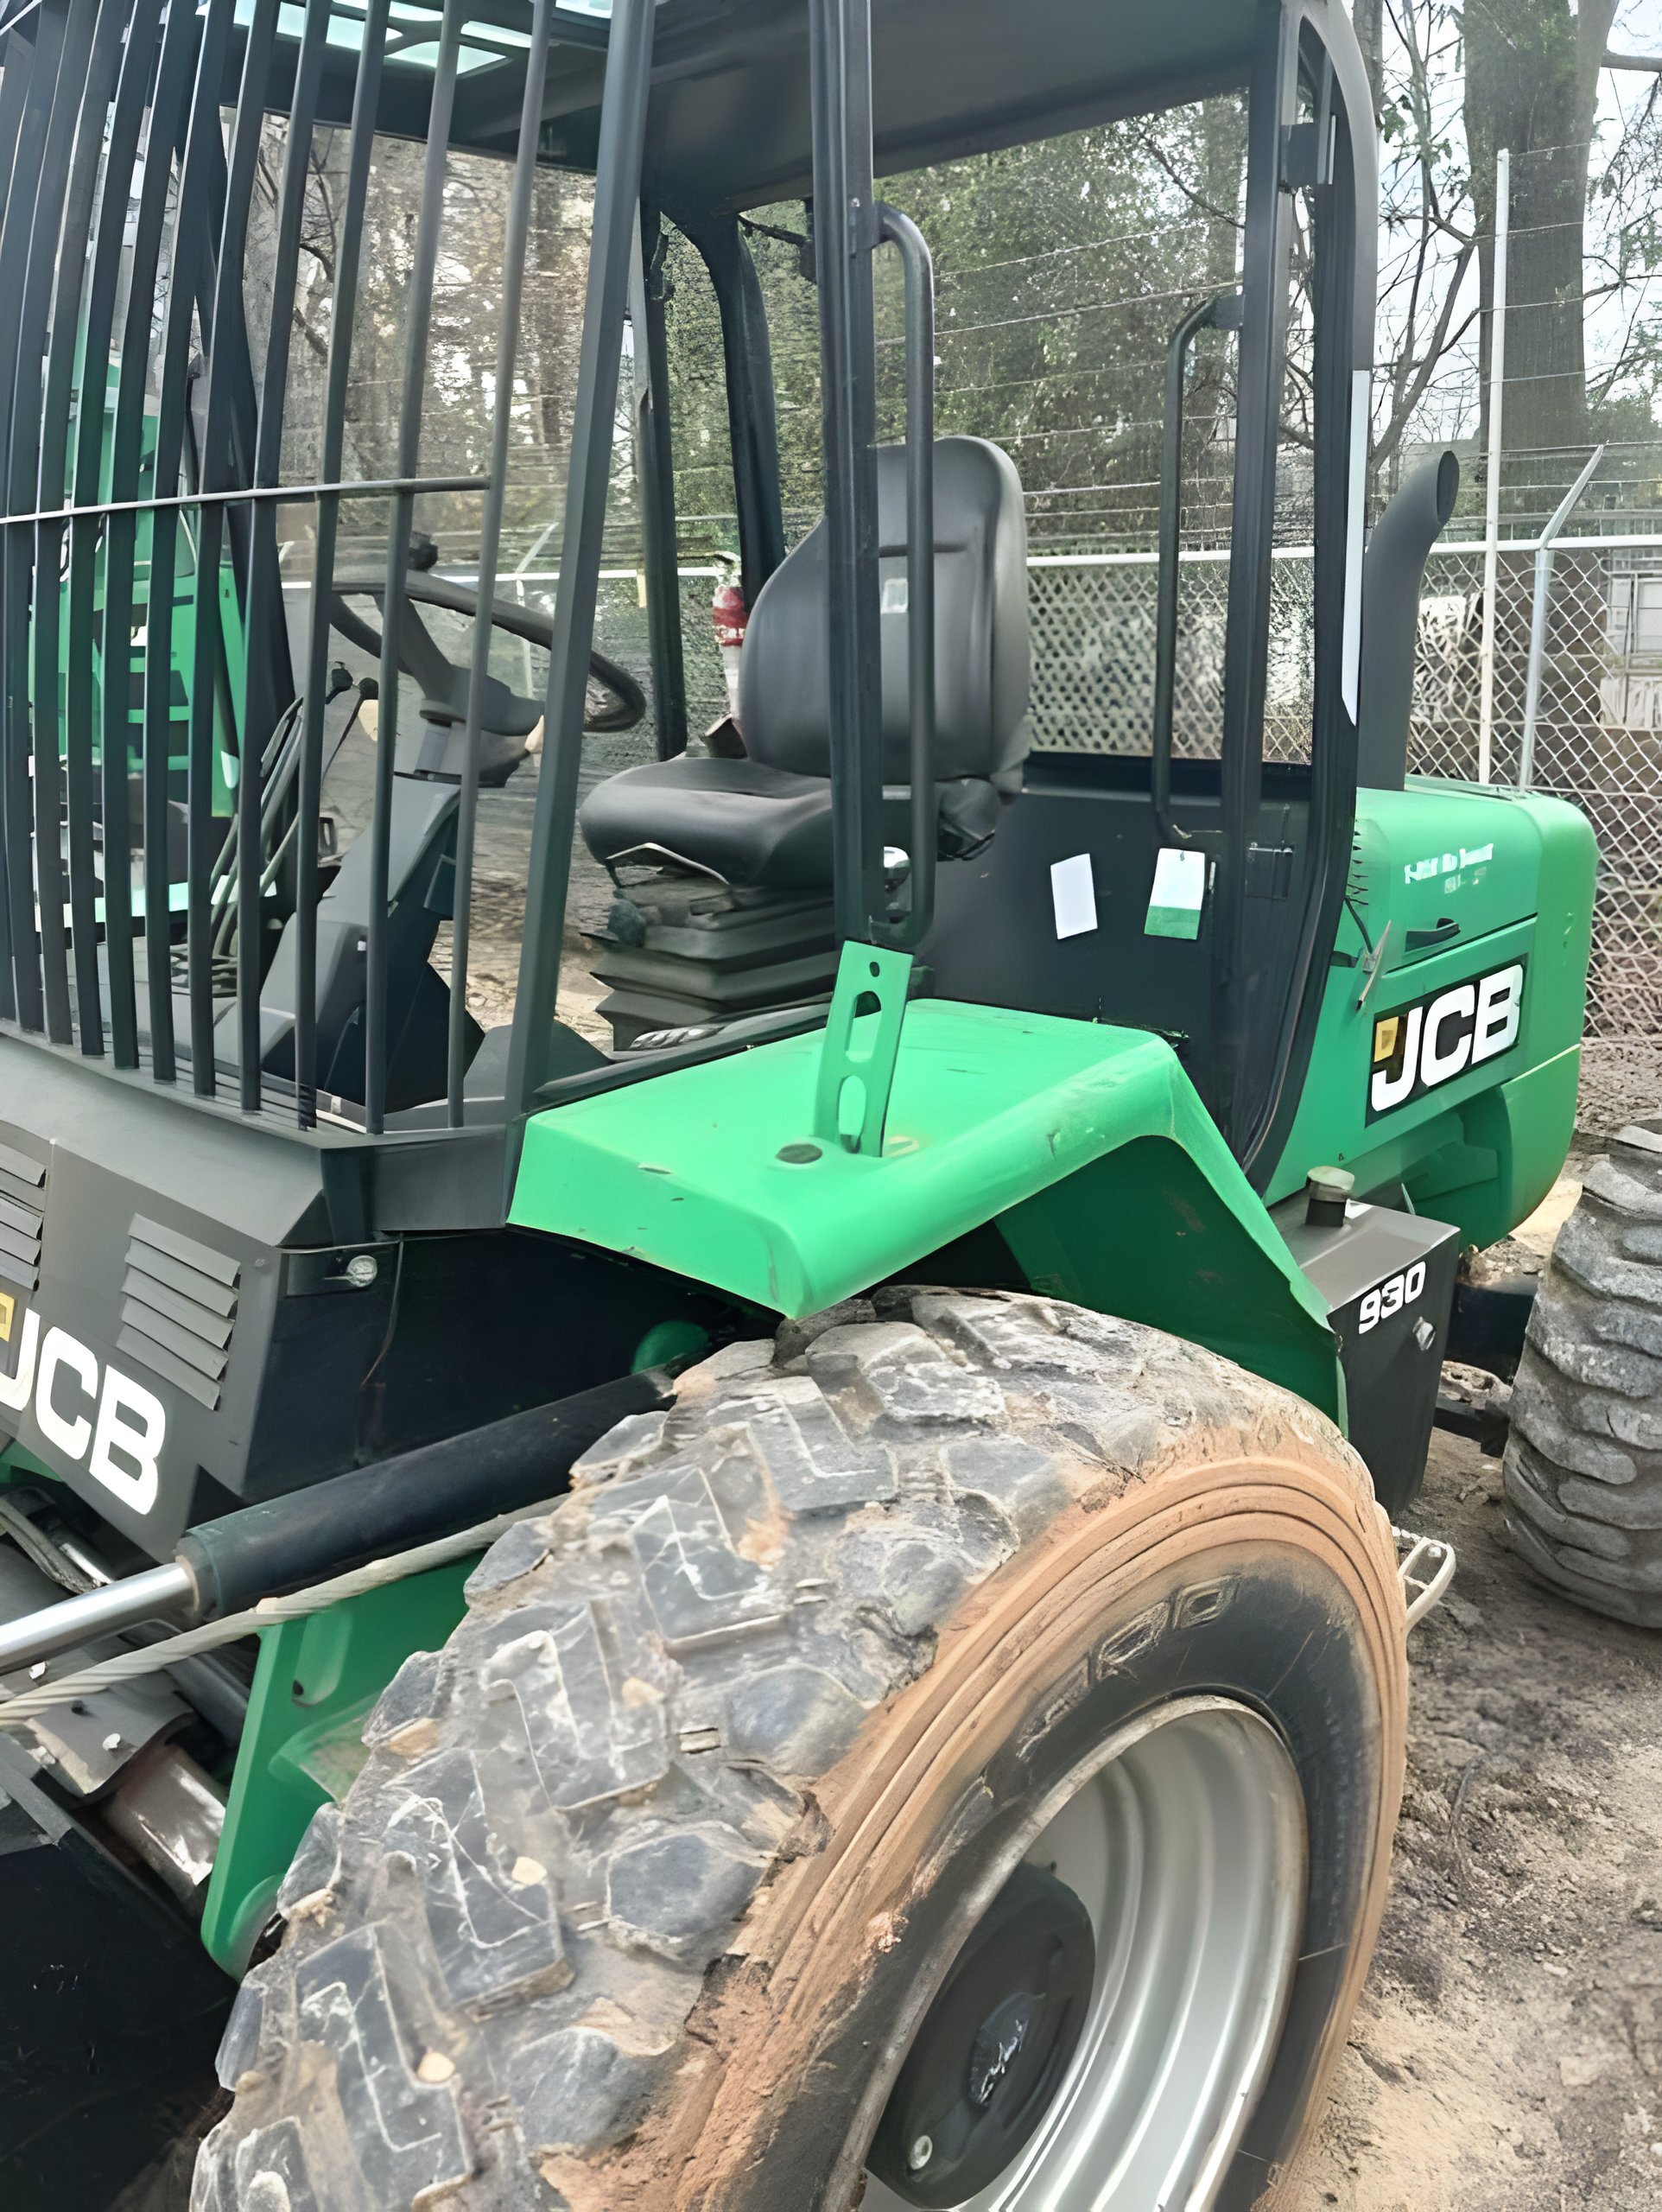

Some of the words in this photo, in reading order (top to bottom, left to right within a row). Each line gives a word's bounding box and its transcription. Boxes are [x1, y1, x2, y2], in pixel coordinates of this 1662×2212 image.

[1371, 964, 1524, 1111] JCB
[1359, 1262, 1426, 1334] 930
[0, 1308, 166, 1516] JCB
